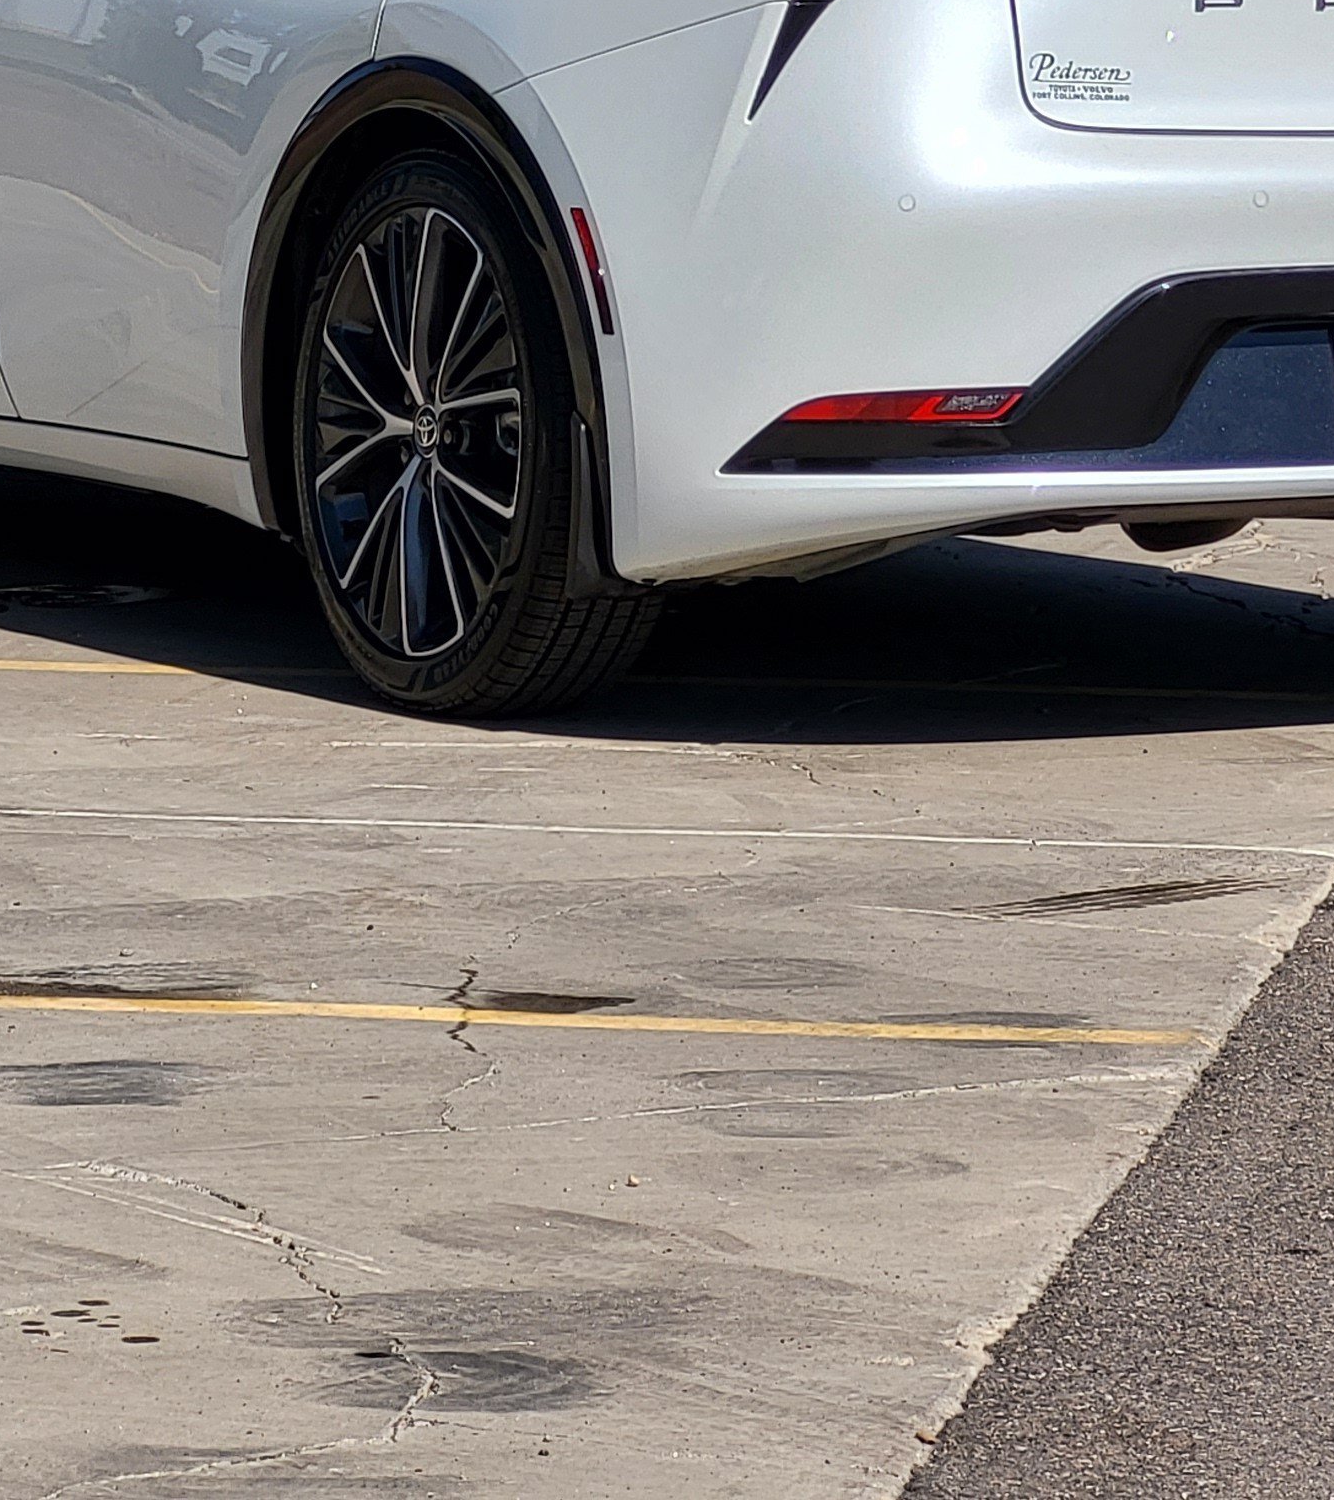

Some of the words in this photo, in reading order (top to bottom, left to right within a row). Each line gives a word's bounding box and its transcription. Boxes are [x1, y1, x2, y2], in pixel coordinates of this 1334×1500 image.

[1028, 52, 1131, 82] Pedersen
[1082, 85, 1114, 94] VOLVO
[1032, 91, 1051, 99] FORT
